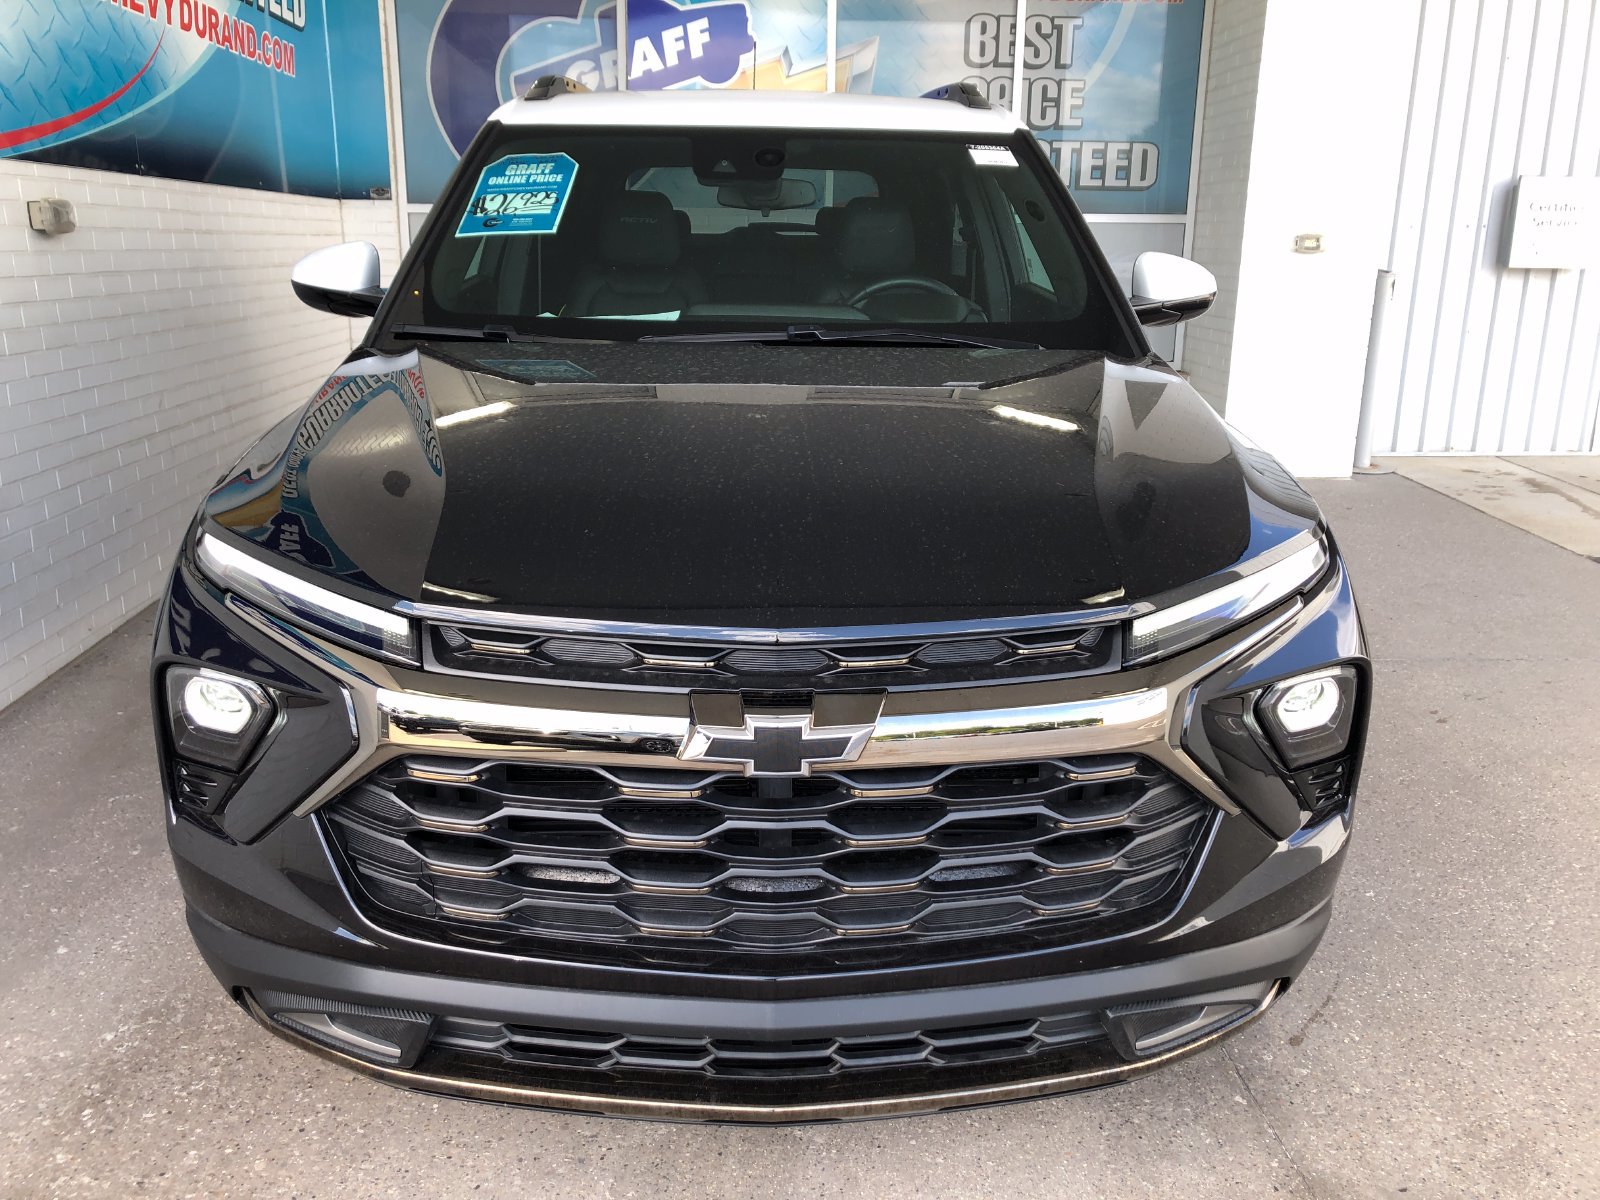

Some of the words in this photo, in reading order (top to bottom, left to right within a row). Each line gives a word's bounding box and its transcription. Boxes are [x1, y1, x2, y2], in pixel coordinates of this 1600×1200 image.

[964, 13, 1084, 69] BEST
[505, 163, 555, 175] GRAFF
[487, 174, 527, 186] ONLINE
[529, 173, 563, 183] PRICE
